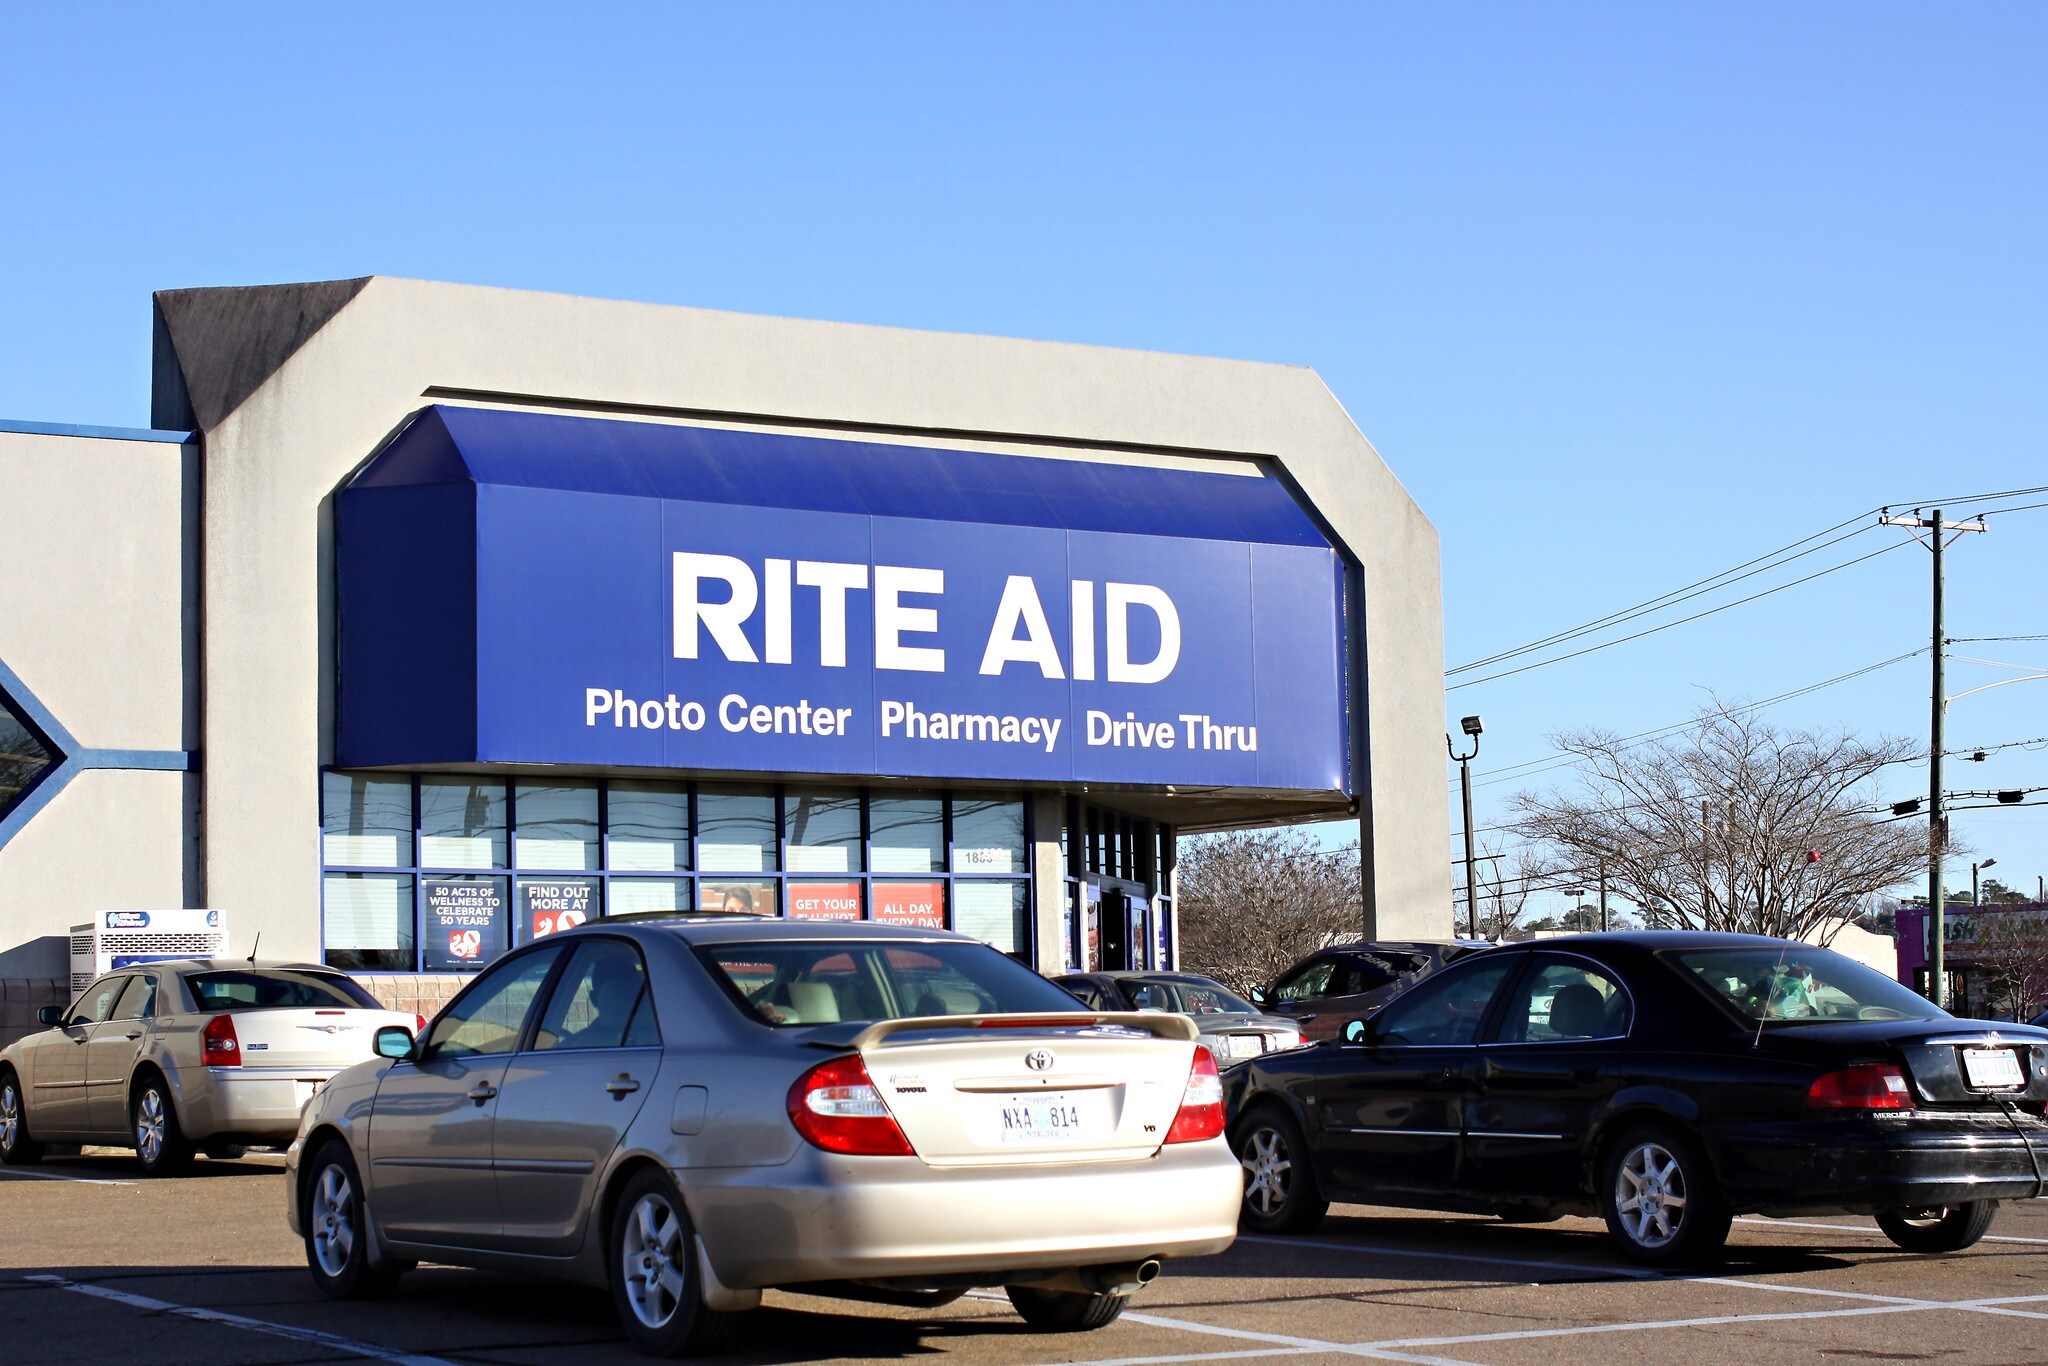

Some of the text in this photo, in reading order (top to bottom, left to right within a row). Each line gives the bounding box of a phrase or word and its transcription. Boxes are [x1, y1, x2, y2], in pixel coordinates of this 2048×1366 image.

[672, 551, 1182, 684] RITE AID
[586, 687, 1258, 753] Photo Center Pharmacy Drive Thru
[435, 887, 495, 897] 50 ACTS OF
[528, 886, 591, 899] FIND OUT
[429, 896, 500, 907] WELLNESS TO
[531, 898, 589, 910] MORE AT
[795, 898, 857, 910] GET YOUR
[436, 906, 494, 917] CELEBRATE
[883, 903, 935, 915] ALL DAY.
[440, 916, 490, 926] 50 YEARS
[895, 1086, 927, 1094] TOYOTA
[1002, 1106, 1078, 1129] NXA 814
[1872, 1111, 1911, 1120] MERCURY
[1143, 1124, 1156, 1132] V6
